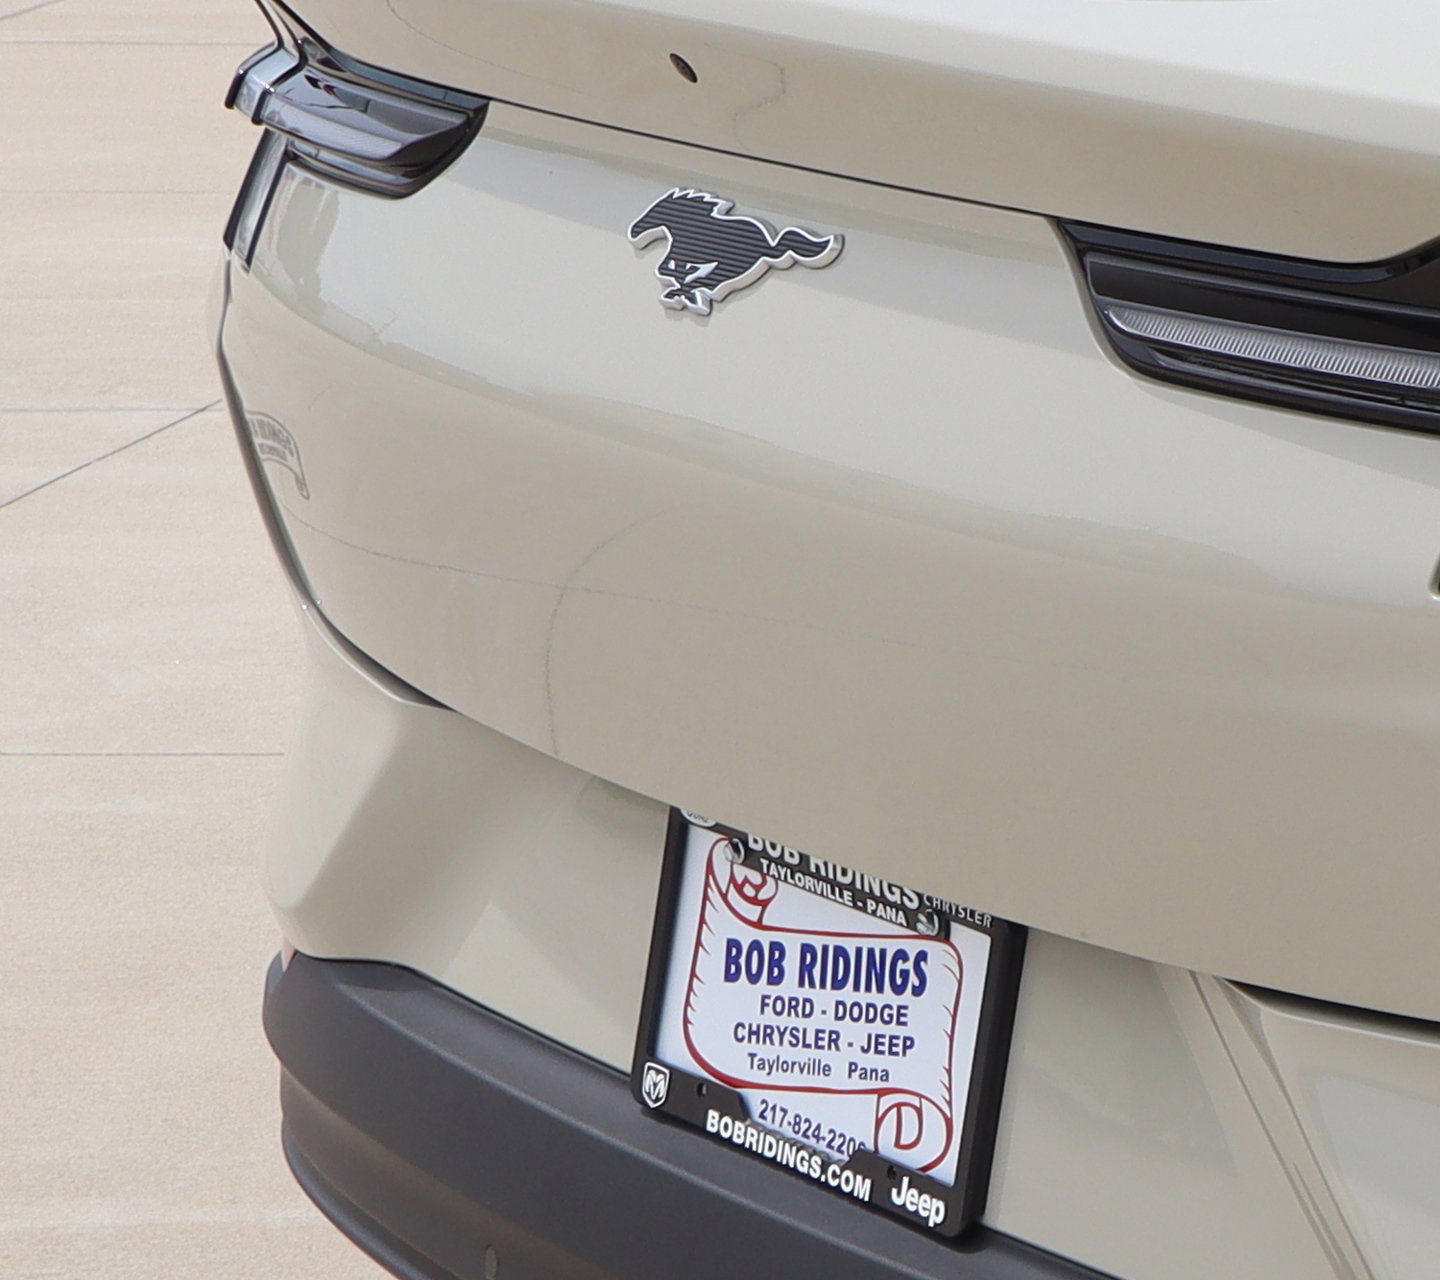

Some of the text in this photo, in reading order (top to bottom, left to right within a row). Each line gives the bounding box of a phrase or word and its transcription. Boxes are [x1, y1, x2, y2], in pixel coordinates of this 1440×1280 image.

[760, 857, 854, 907] TAYLORVILLE
[866, 899, 908, 927] PANA
[923, 893, 993, 929] CHRYSLER
[724, 937, 928, 998] BOB RIDINGS
[760, 994, 815, 1019] FORD
[834, 1000, 909, 1027] DODGE
[733, 1022, 841, 1052] CHRYSLER
[860, 1032, 915, 1057] JEEP
[747, 1052, 890, 1082] Taylorville Pana
[706, 1108, 871, 1202] BOBRIDINGS.COM
[891, 1176, 945, 1228] Jeep
